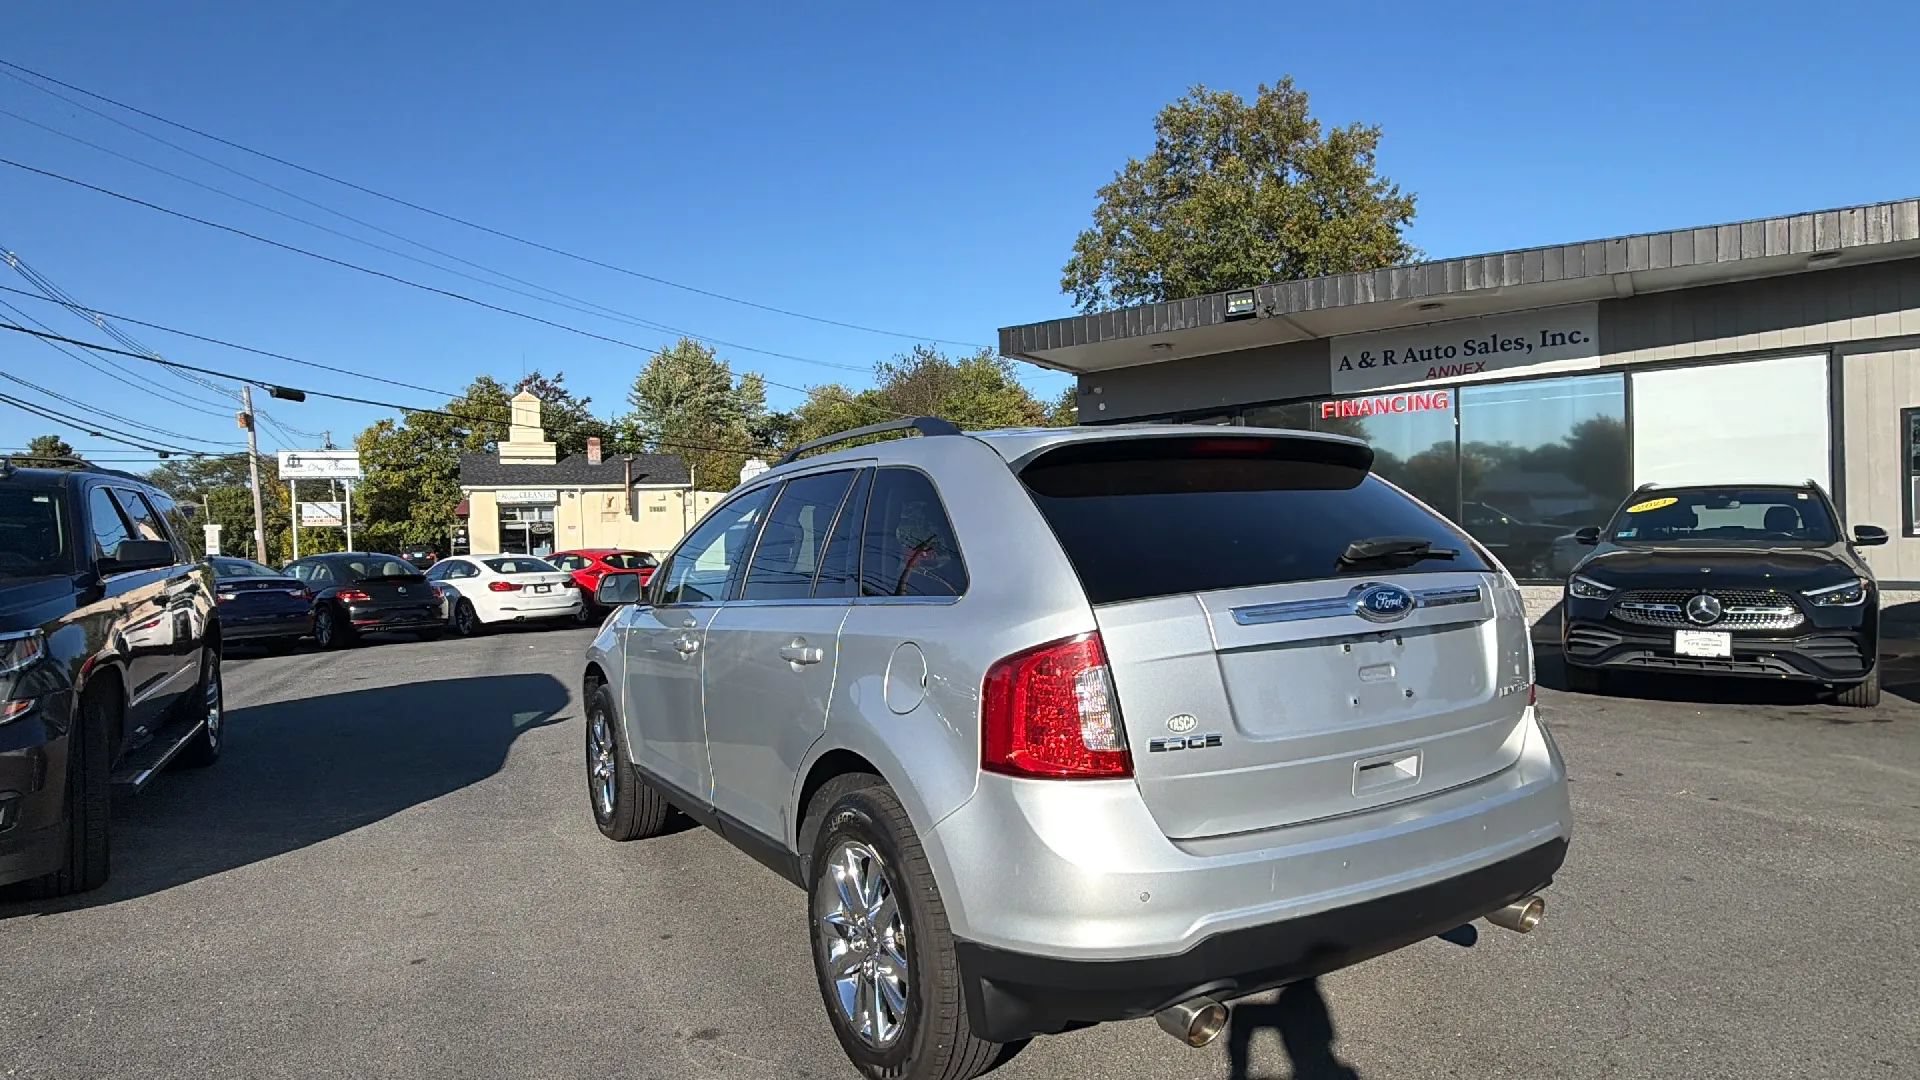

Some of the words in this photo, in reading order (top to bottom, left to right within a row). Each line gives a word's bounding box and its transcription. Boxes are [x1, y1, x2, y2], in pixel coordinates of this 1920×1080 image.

[1338, 355, 1354, 371] A
[1358, 351, 1377, 368] &
[1382, 349, 1398, 366] R
[1402, 345, 1457, 364] Auto
[1463, 333, 1533, 356] Sales,
[1540, 329, 1590, 348] Inc.
[1426, 360, 1486, 379] ANNEX
[1321, 390, 1449, 420] FINANCING
[1375, 591, 1404, 610] Ford
[1168, 715, 1195, 731] TASCA
[1146, 734, 1222, 753] EDGE
